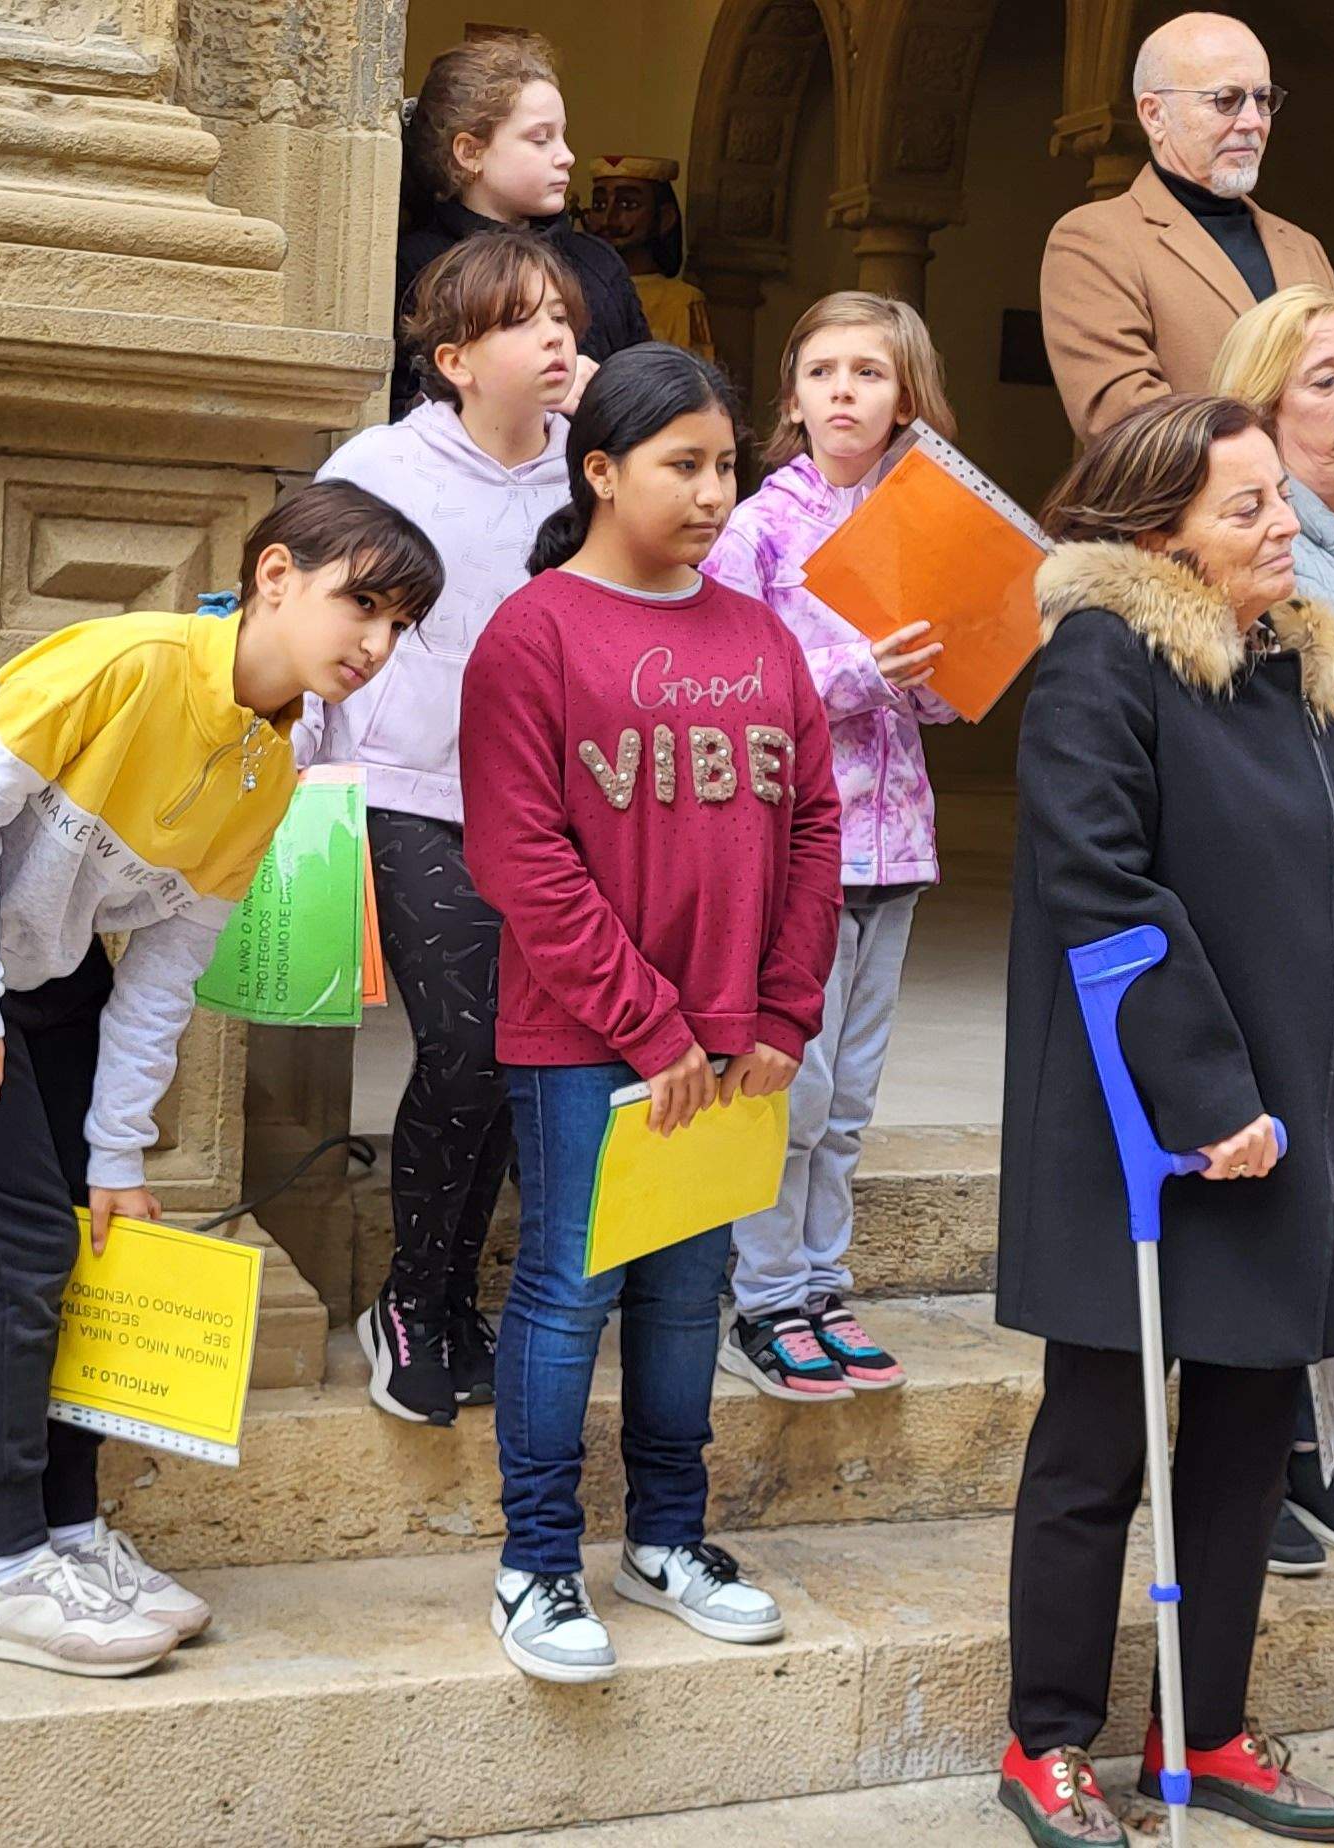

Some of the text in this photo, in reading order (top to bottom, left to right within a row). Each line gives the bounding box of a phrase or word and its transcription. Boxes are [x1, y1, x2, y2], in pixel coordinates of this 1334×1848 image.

[631, 646, 764, 709] Good
[578, 723, 796, 810] VIBE
[38, 785, 91, 843] MAKE
[242, 922, 252, 934] O
[279, 909, 292, 928] DE
[255, 909, 272, 1000] PROTEGIDOS
[275, 930, 291, 1002] CONSUMO
[237, 981, 249, 998] EL
[71, 1282, 233, 1328] COMPRADO O VENDIDO
[79, 1323, 113, 1342] NIÑA
[119, 1332, 130, 1345] O
[136, 1335, 170, 1357] NIÑO
[203, 1331, 231, 1349] SER
[176, 1341, 229, 1370] NINGÚN
[81, 1364, 169, 1397] ARTÍCULO 35
